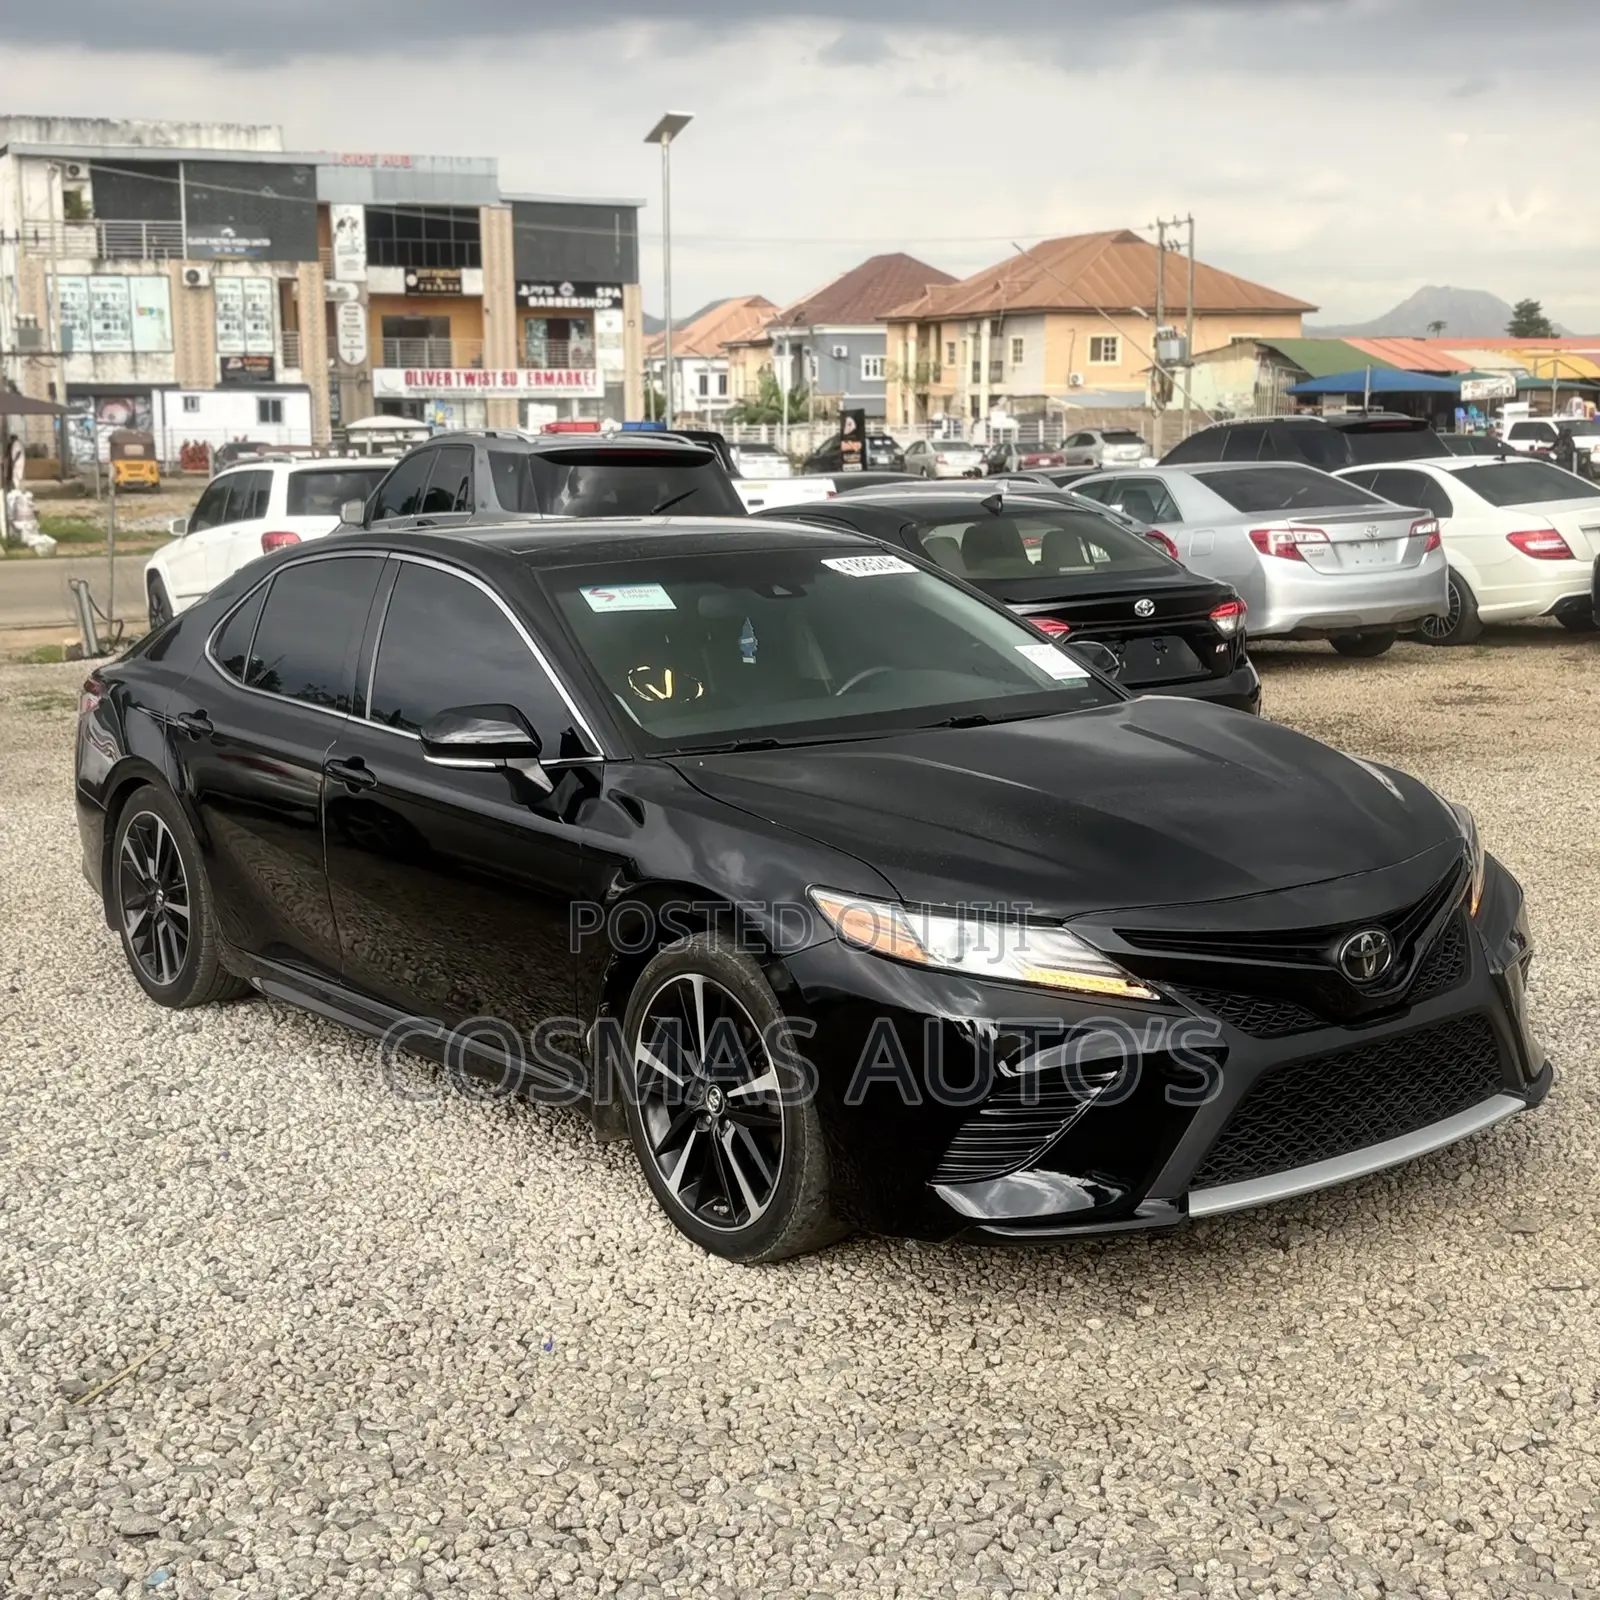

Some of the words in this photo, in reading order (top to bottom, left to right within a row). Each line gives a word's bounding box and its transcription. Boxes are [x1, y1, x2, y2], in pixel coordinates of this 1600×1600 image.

[595, 286, 622, 298] SPA
[528, 296, 613, 308] BARBERSHOP
[405, 370, 452, 386] OLIVER
[455, 370, 497, 386] TWIST
